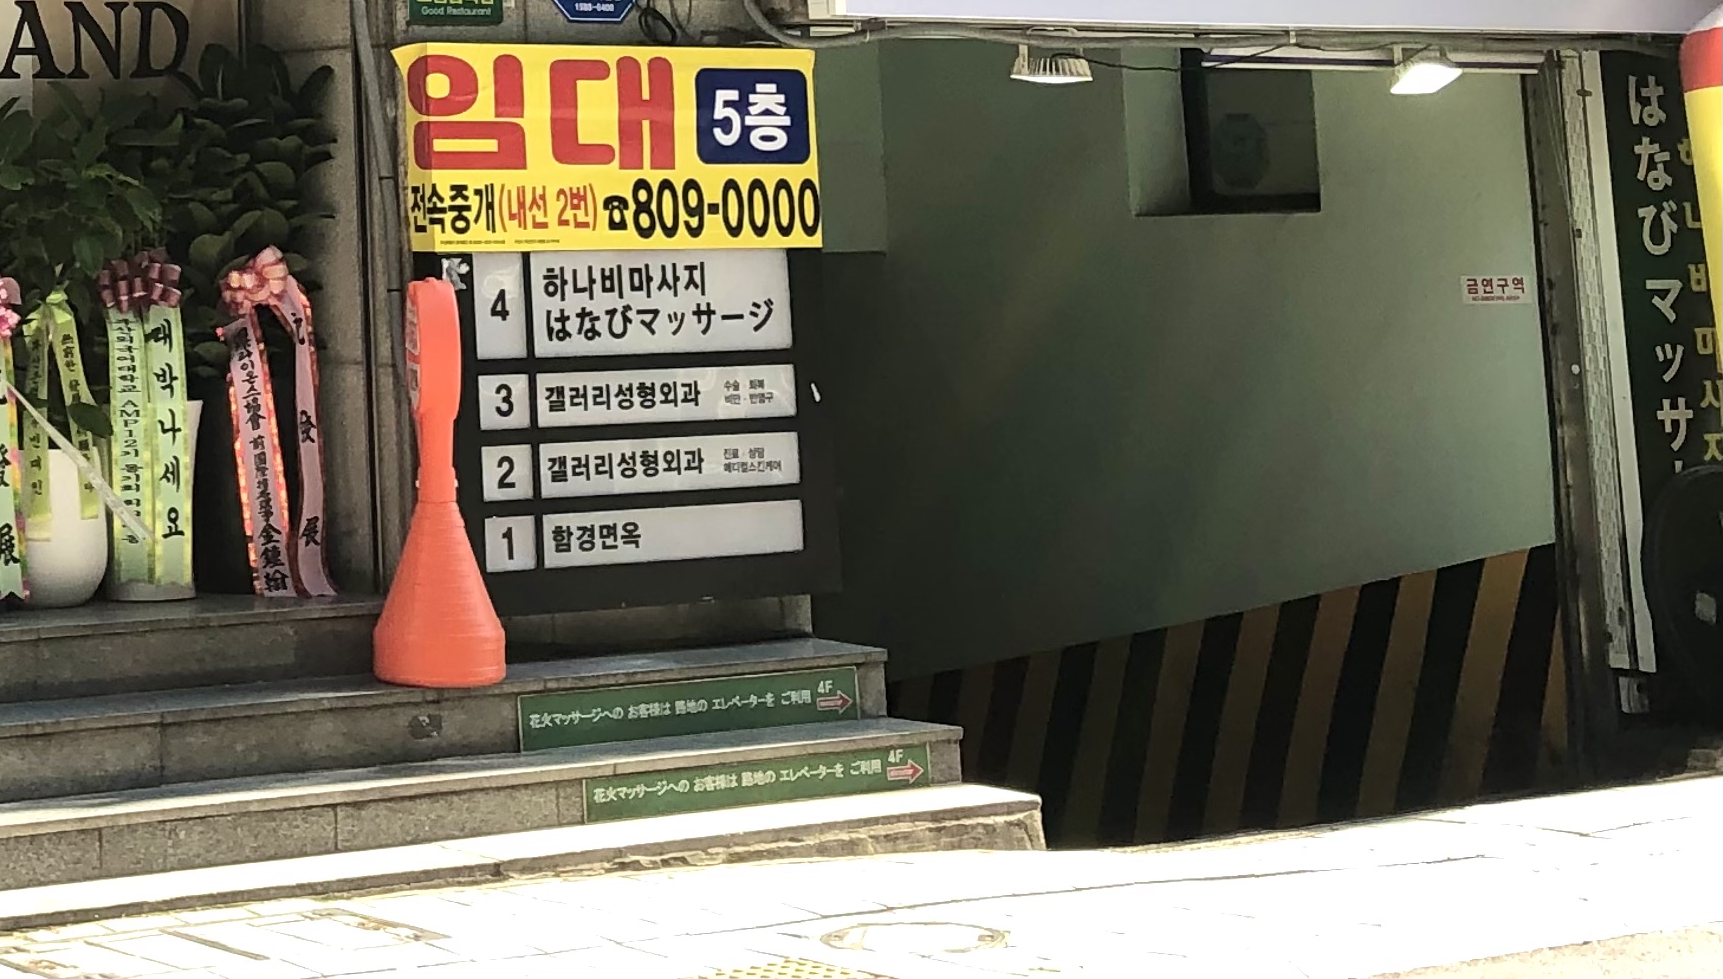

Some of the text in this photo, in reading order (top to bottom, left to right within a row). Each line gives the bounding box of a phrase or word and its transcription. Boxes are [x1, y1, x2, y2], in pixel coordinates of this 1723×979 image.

[421, 6, 444, 16] Good
[407, 54, 792, 171] 임대 5층
[631, 178, 822, 239] 809-0000
[543, 261, 707, 300] 하나비마사지
[1466, 276, 1525, 295] 금연구역
[1628, 74, 1694, 473] はなびマッサ
[491, 289, 509, 322] 4
[545, 298, 775, 342] はなびマッサージ
[495, 384, 514, 417] 3
[544, 380, 701, 413] 갤러리성형외과
[497, 455, 516, 489] 2
[547, 448, 705, 483] 갤러리성형외과
[501, 526, 515, 561] 1
[550, 521, 642, 554] 함경면옥
